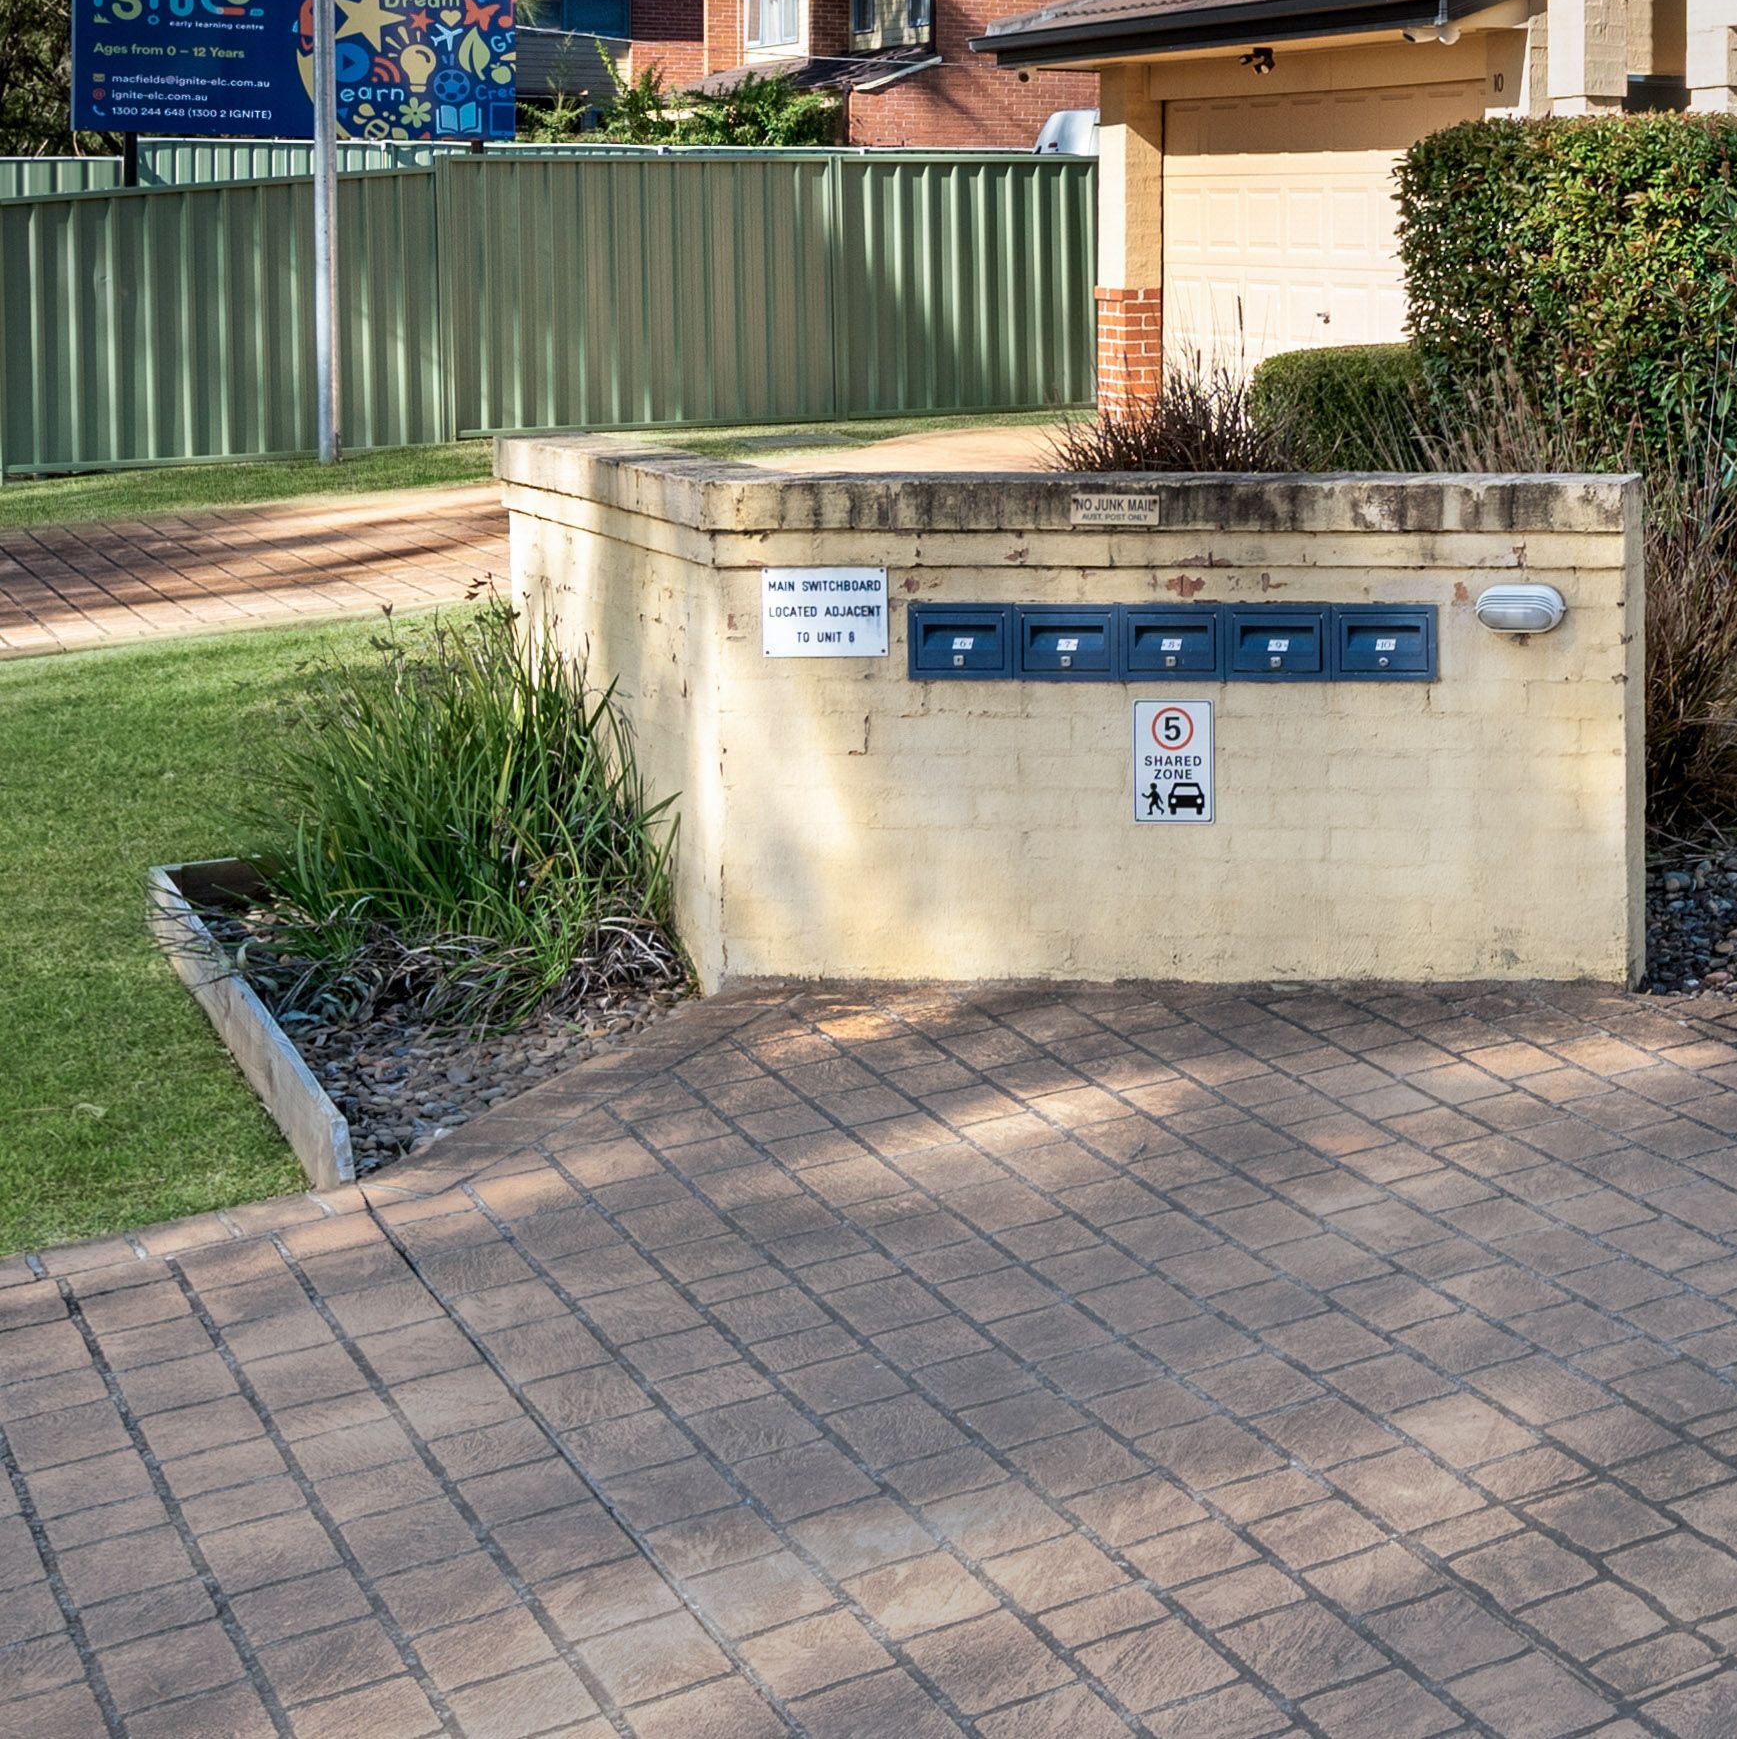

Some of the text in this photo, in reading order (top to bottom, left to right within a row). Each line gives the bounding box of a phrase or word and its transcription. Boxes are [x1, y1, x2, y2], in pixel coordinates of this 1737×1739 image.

[169, 20, 265, 31] early learning centre
[93, 42, 128, 57] Ages
[132, 44, 164, 56] from
[167, 45, 177, 56] 0
[193, 47, 207, 57] 12
[209, 47, 245, 59] Years
[112, 74, 271, 88] macfields@ignite-elc.com.au
[1493, 72, 1504, 92] 10
[112, 90, 208, 102] ignite-elc.com.au
[340, 86, 405, 102] earn
[112, 107, 273, 120] 1300 244 648 (1300 2 IGNITE)
[1076, 499, 1154, 512] NO JUNK MAIL
[1105, 513, 1125, 521] POST
[1128, 513, 1148, 521] ONLY
[768, 580, 882, 592] MAIN SWITCHBOARD
[769, 605, 882, 617] LOCATED ADJACENT
[797, 631, 810, 643] TO
[817, 631, 842, 643] UNIT
[1164, 716, 1181, 741] 5
[1144, 755, 1202, 767] SHARED
[1154, 768, 1192, 780] ZONE
